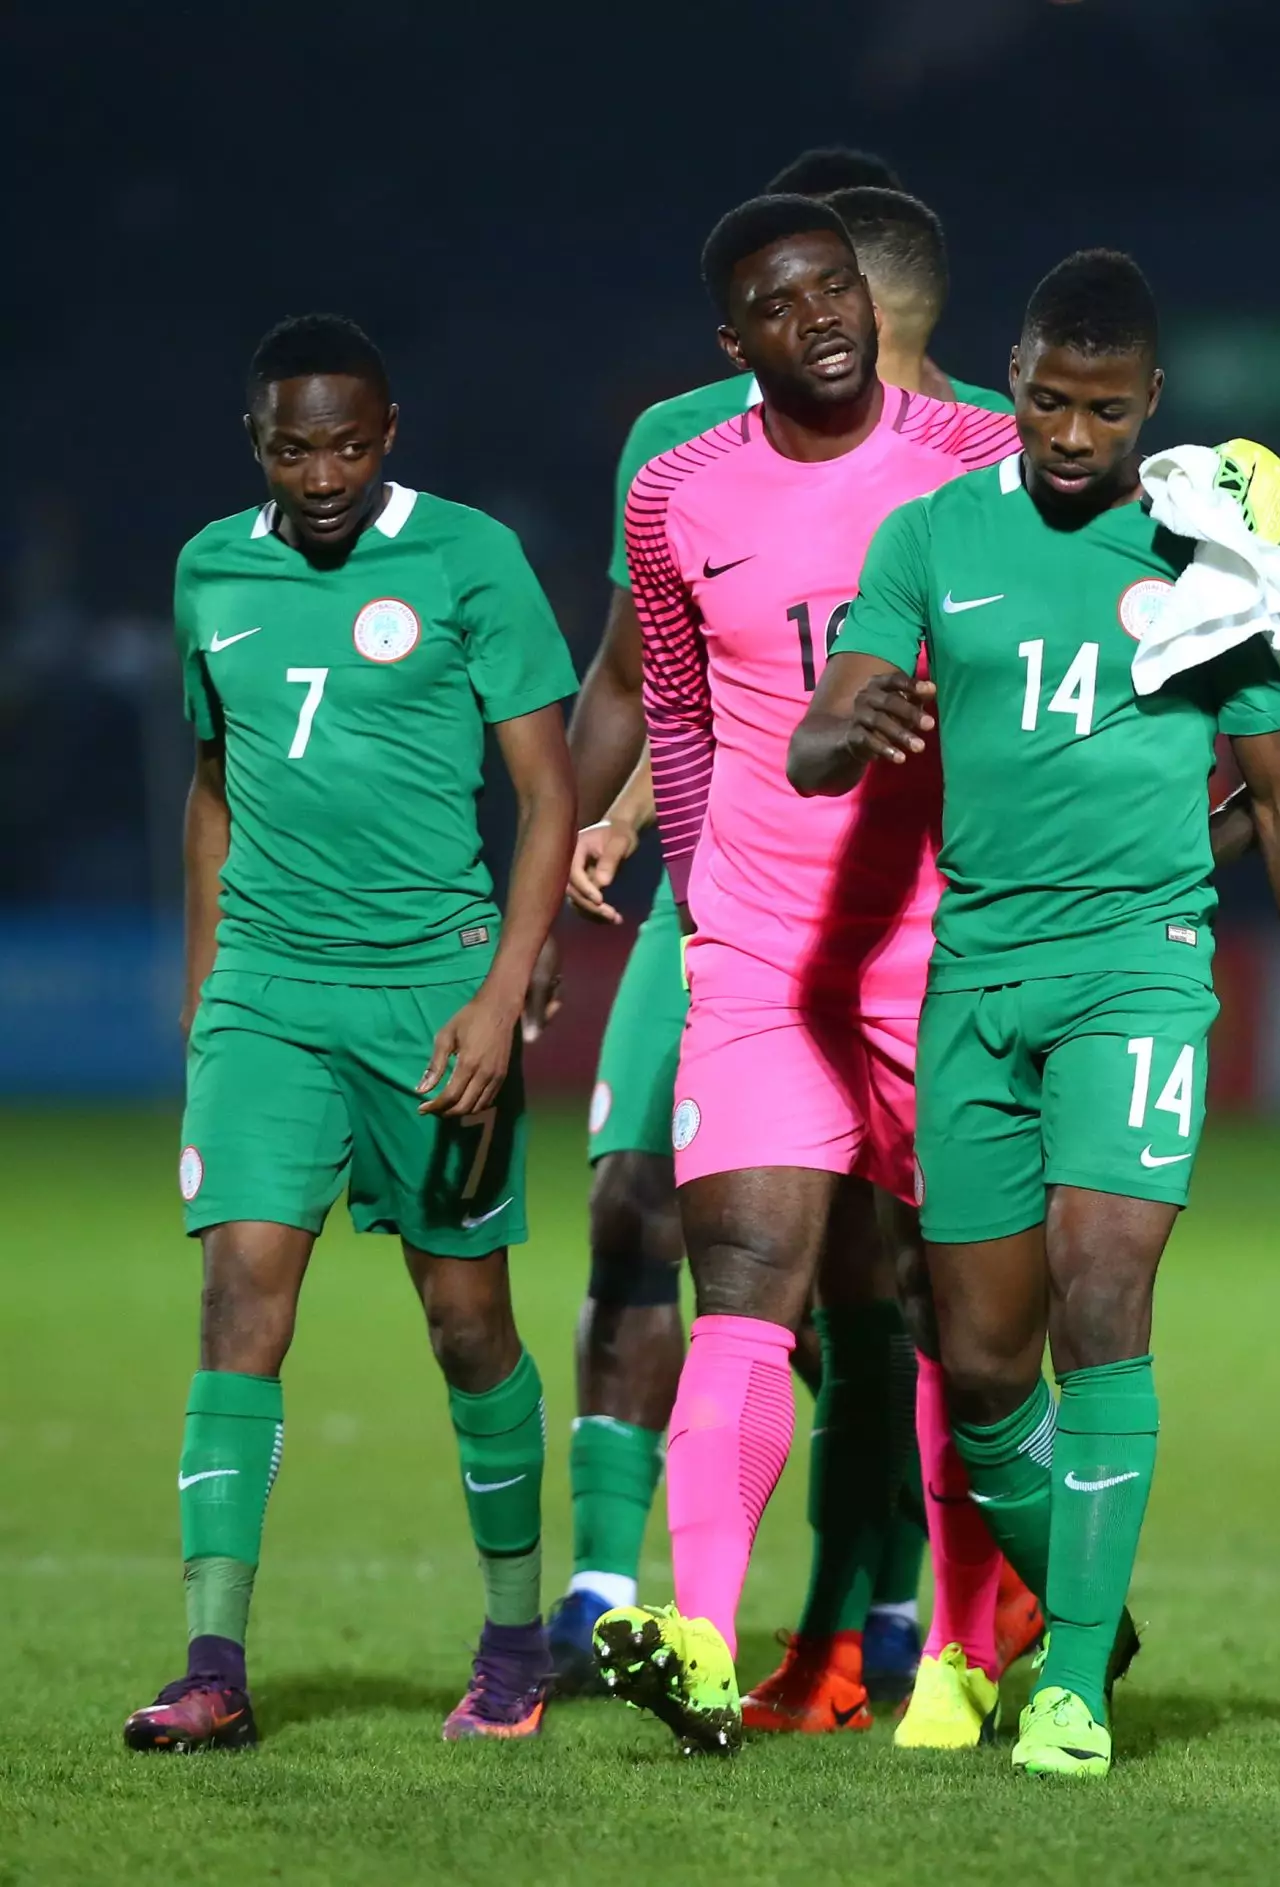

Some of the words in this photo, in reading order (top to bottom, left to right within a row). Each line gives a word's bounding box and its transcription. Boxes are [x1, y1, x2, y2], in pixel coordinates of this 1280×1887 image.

[286, 667, 329, 759] 7
[1018, 639, 1099, 736] 14
[1127, 1036, 1194, 1137] 14
[460, 1107, 498, 1199] 7
